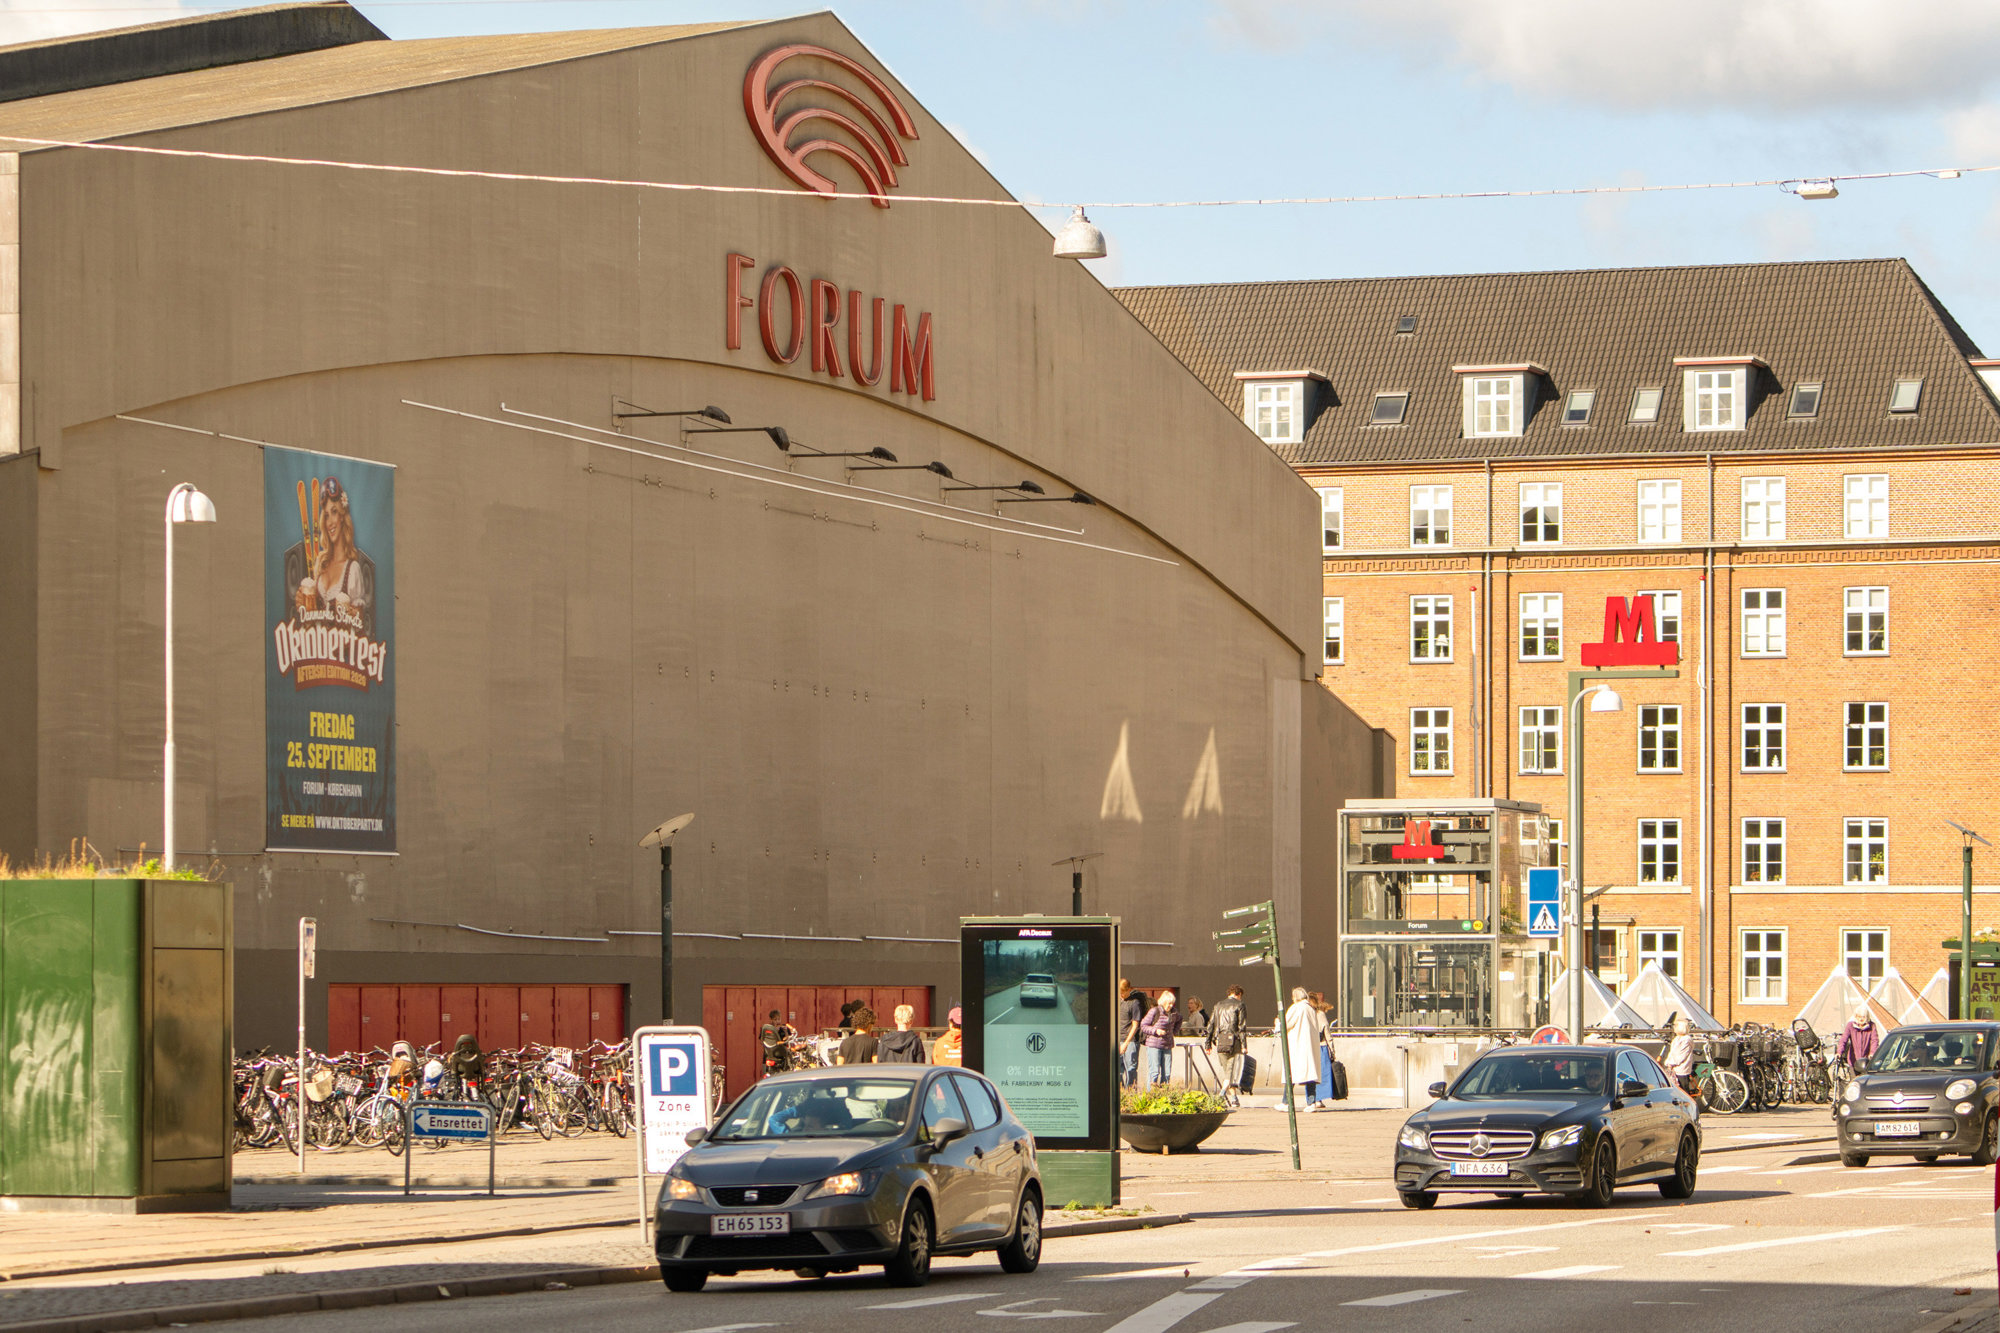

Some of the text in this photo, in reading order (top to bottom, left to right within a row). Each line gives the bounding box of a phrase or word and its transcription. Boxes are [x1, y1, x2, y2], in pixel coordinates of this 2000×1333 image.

[727, 254, 935, 401] FORUM
[299, 601, 334, 623] Danmarks
[274, 618, 386, 682] Oktoberfest
[310, 711, 355, 740] FREDAG
[287, 741, 376, 773] 25. SEPTEMBER
[303, 781, 362, 797] FORUM KØBENHAVN
[281, 814, 290, 828] SE
[290, 814, 306, 828] MERE
[307, 812, 314, 828] PÅ
[1974, 972, 1996, 982] LET
[1971, 982, 2000, 995] AST
[1028, 1034, 1044, 1052] MG
[660, 1048, 689, 1092] P
[1007, 1066, 1022, 1076] 0%
[658, 1100, 692, 1112] Zone
[430, 1116, 482, 1129] Ensrettet
[1903, 1124, 1918, 1132] 614
[1460, 1163, 1503, 1174] NFA 636
[758, 1216, 783, 1230] 153
